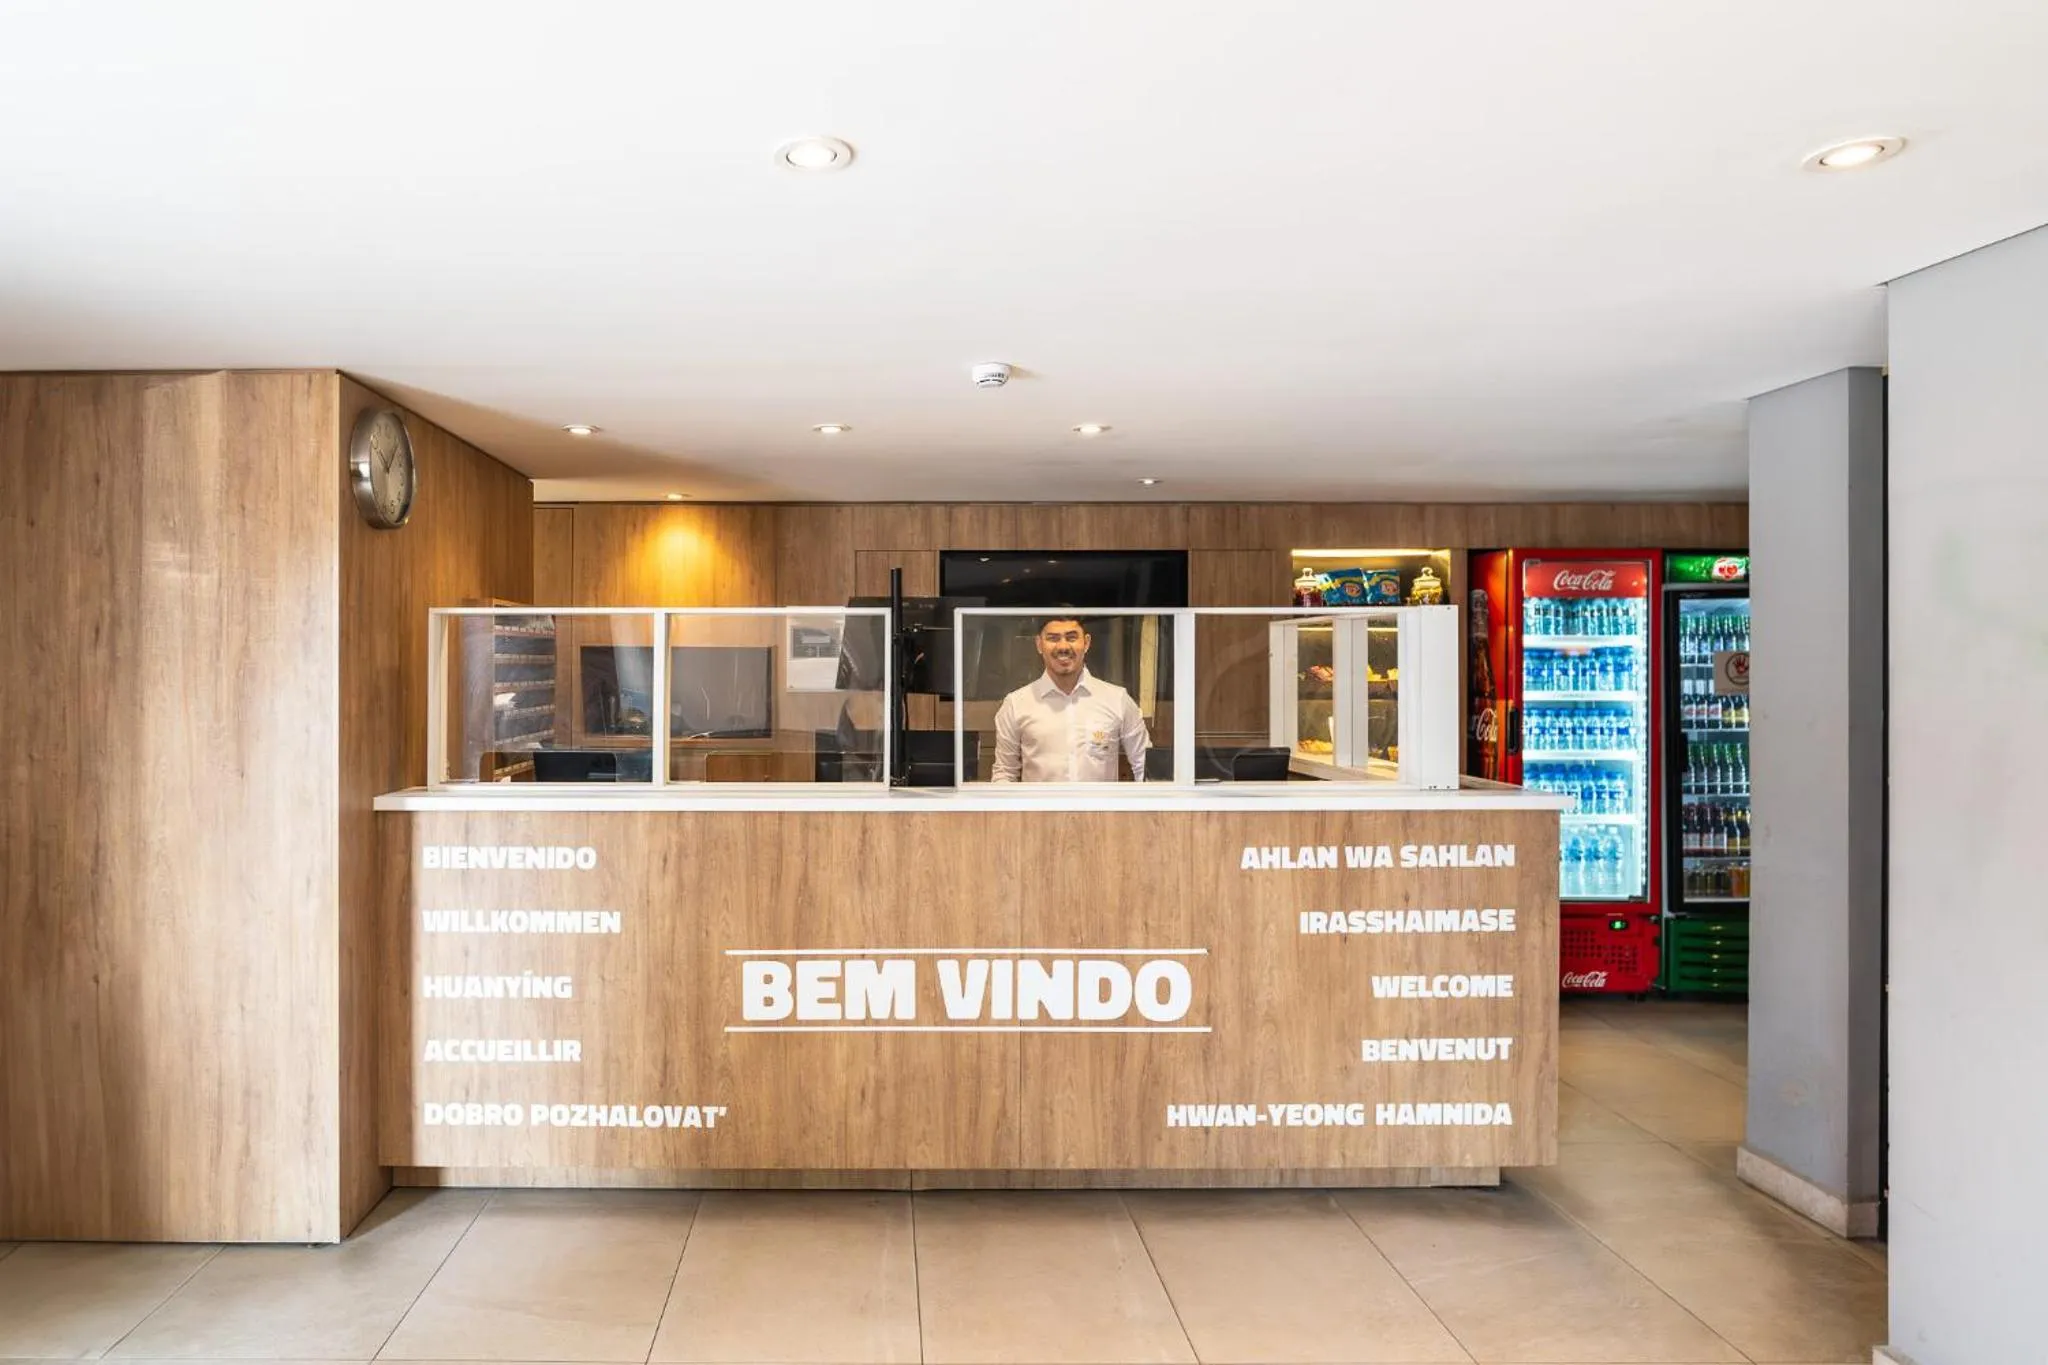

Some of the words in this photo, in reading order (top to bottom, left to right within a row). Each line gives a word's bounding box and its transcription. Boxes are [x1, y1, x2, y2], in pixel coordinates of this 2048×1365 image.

[422, 846, 597, 870] BIENVENIDO
[1240, 846, 1338, 870] AHLAN
[1345, 845, 1394, 869] WA
[1399, 844, 1515, 868] SAHLAN
[422, 909, 622, 934] WILLKOMMEN
[1299, 908, 1516, 935] IRASSHAIMASE
[742, 959, 916, 1021] BEM
[936, 959, 1192, 1024] VINDO
[1371, 974, 1514, 998] WELCOME
[423, 1038, 582, 1063] ACCUEILLIR
[1361, 1037, 1514, 1063] BENVENUT
[423, 1102, 524, 1127] DOBRO
[1166, 1103, 1365, 1128] HWAN-YEONG
[1375, 1103, 1513, 1126] HAMNIDA
